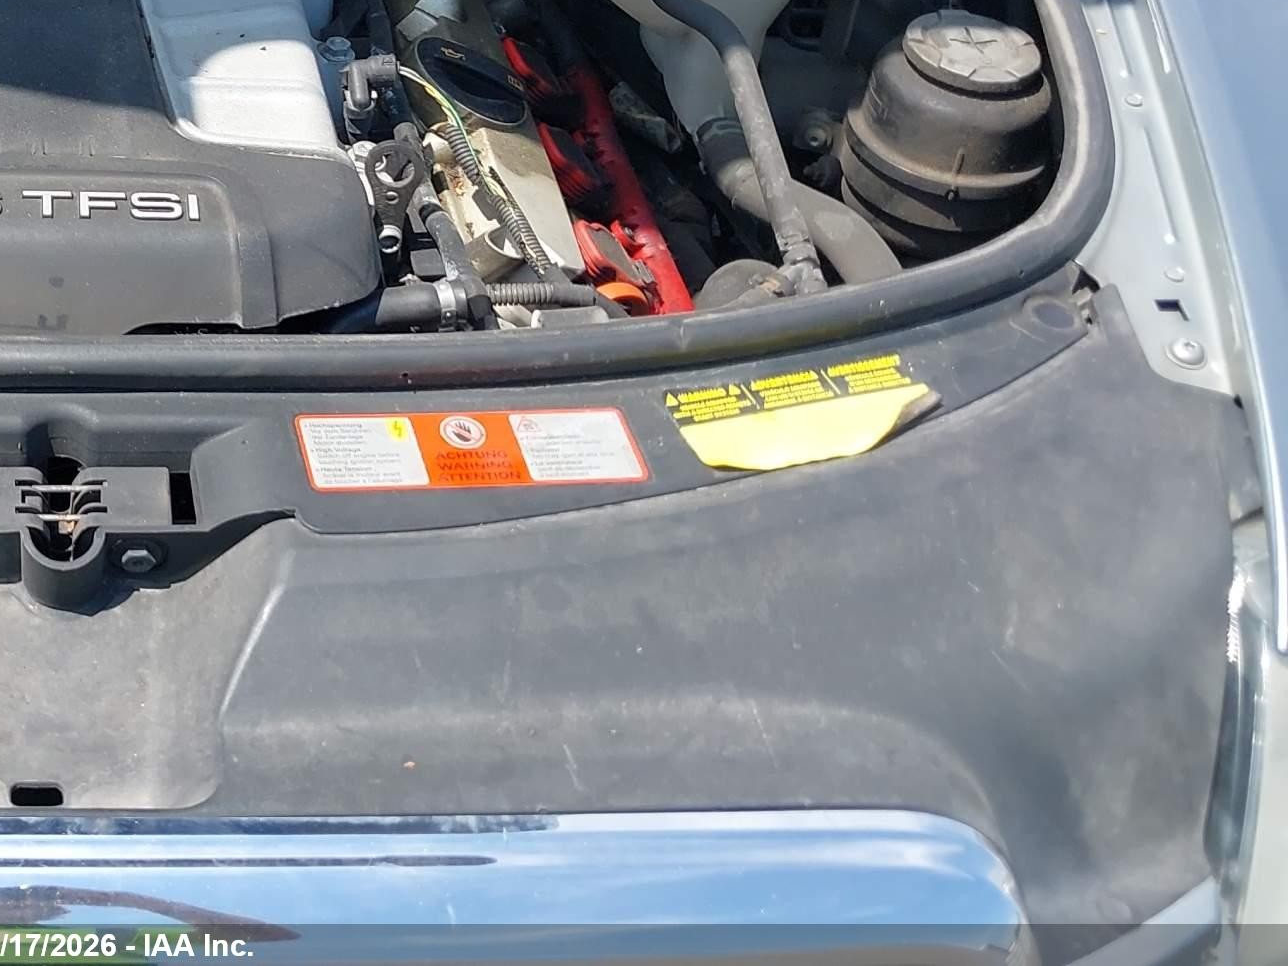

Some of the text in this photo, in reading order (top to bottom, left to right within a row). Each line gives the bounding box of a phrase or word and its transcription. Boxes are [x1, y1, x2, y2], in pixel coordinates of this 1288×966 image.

[22, 190, 202, 221] TFSI
[434, 450, 508, 458] ACHTUNG
[437, 461, 513, 470] WARNING
[437, 471, 522, 481] ATTENTION
